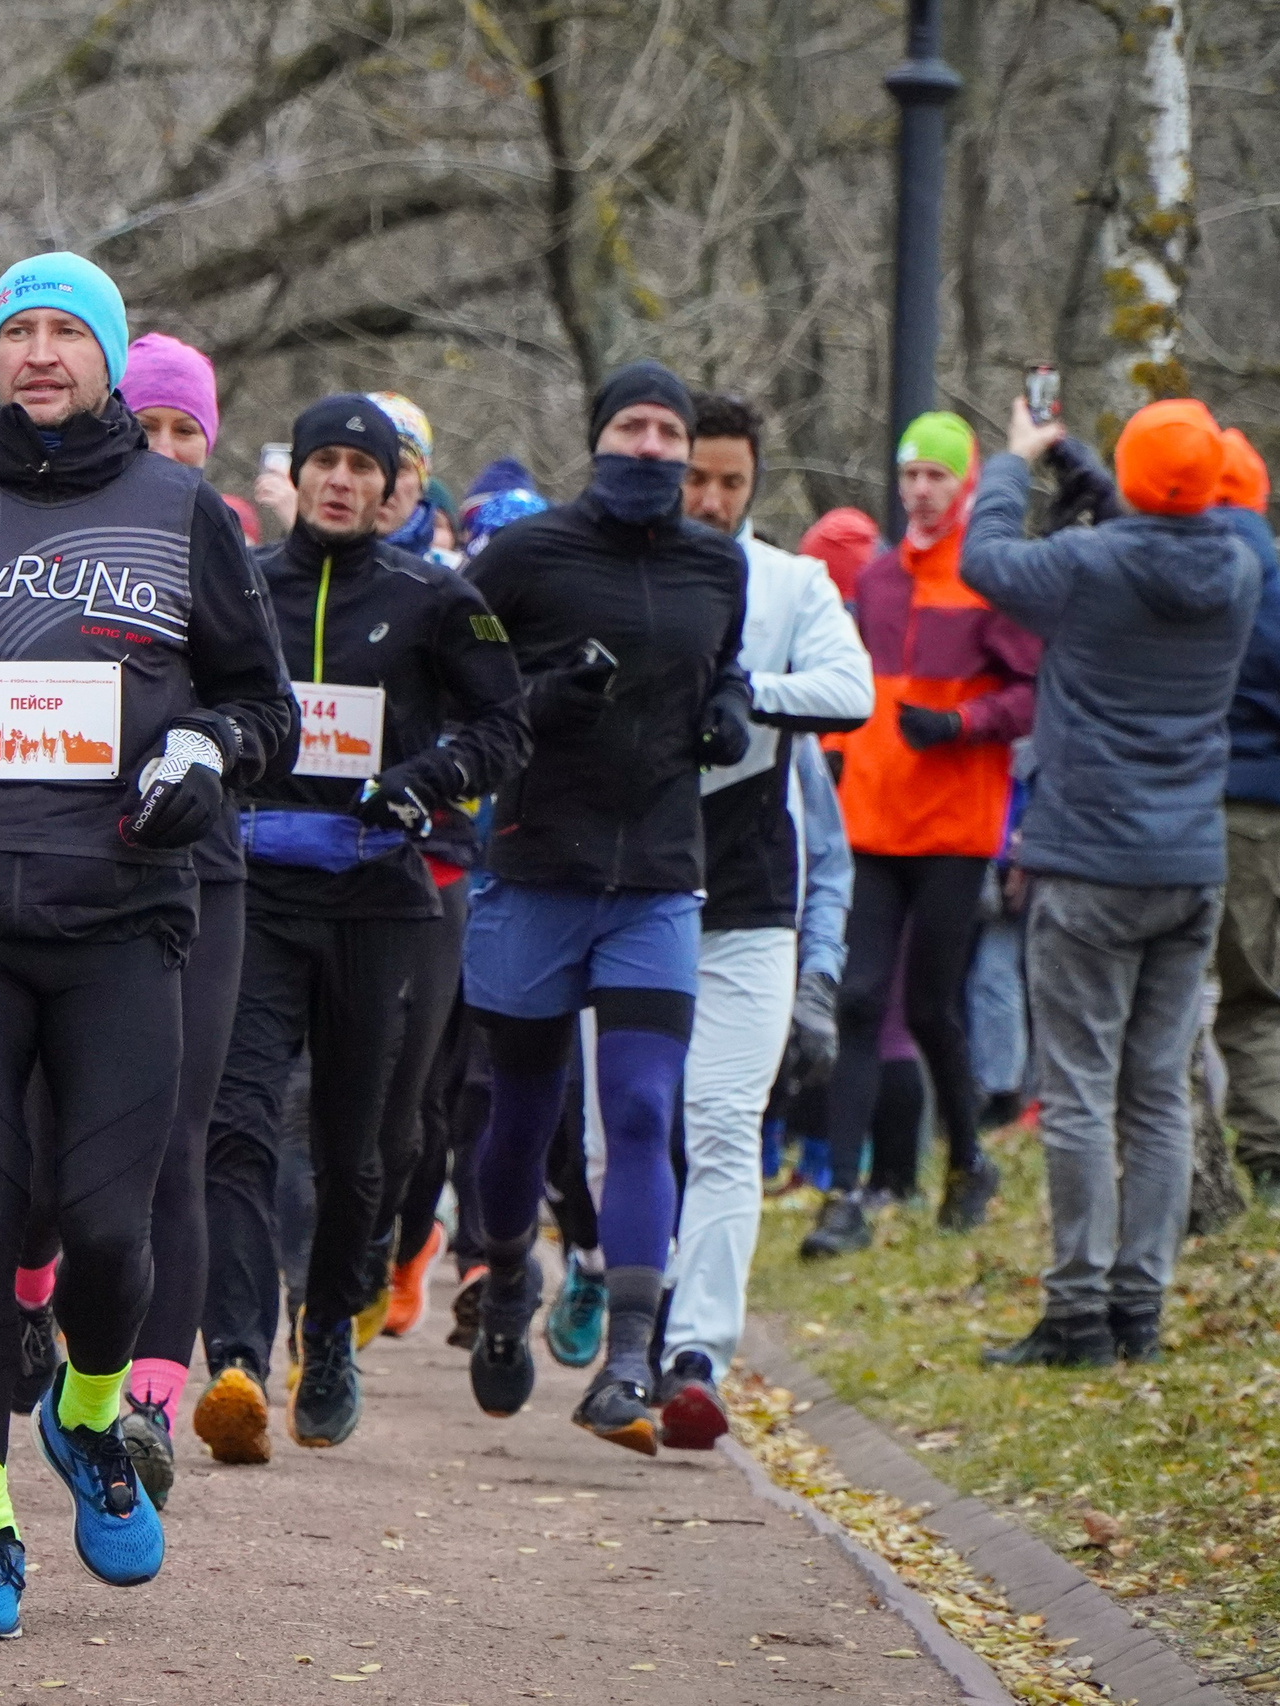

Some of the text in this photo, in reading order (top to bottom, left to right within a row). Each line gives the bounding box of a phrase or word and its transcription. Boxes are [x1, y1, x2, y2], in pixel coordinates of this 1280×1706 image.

[14, 274, 36, 287] ski
[15, 281, 57, 298] grom
[10, 695, 63, 710] ПЕЙСЕР
[301, 700, 337, 720] 144
[131, 785, 165, 832] loopline
